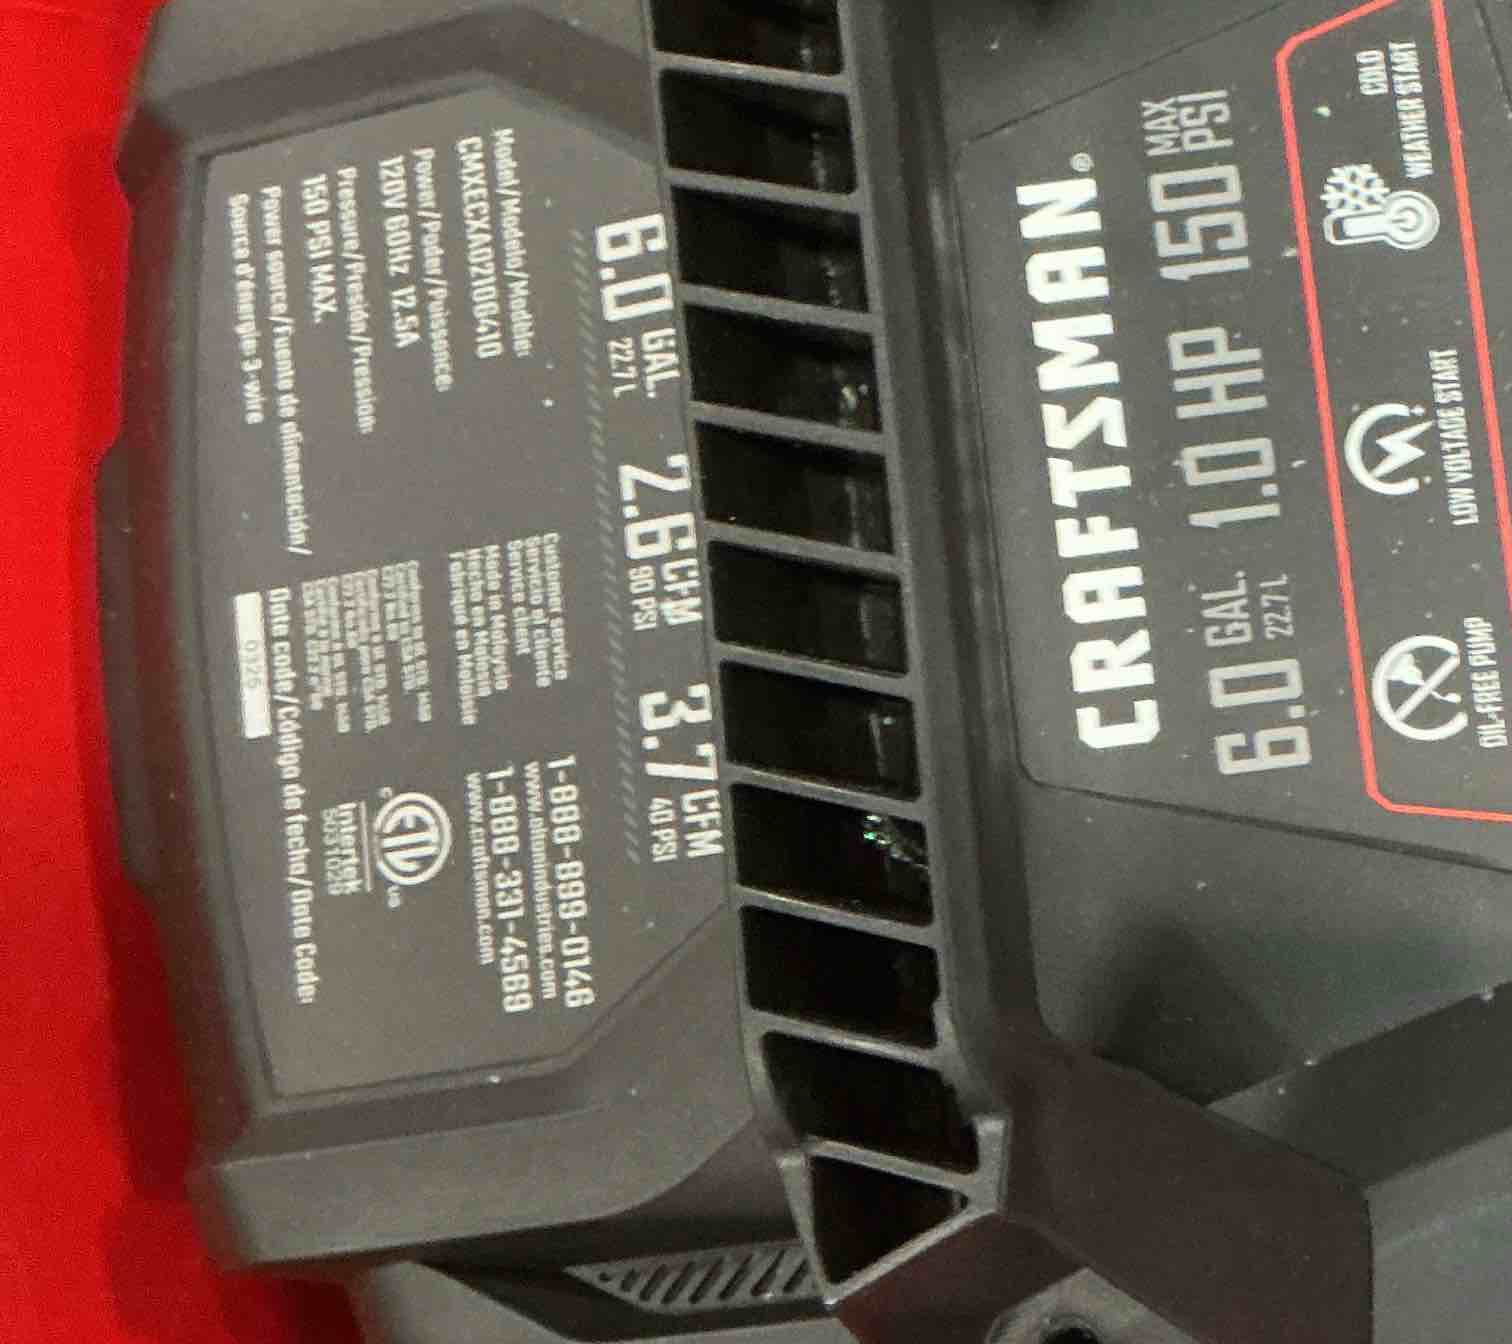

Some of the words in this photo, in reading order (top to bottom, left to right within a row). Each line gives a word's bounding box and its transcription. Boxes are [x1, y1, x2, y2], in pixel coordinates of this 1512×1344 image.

[1356, 49, 1388, 94] COLD
[1389, 40, 1423, 92] START
[1141, 95, 1180, 155] MAX
[1178, 88, 1234, 152] PSI
[1397, 97, 1434, 177] WEATHER
[300, 174, 329, 216] 150
[379, 155, 408, 208] 120V
[228, 193, 253, 261] Source
[304, 220, 332, 260] PSI
[385, 214, 414, 277] 60Hz
[1149, 163, 1251, 281] 150
[260, 186, 284, 246] Power
[279, 394, 299, 416] de
[309, 264, 338, 323] MAX.
[391, 285, 420, 348] 12.5A
[594, 214, 674, 323] 6.0
[640, 328, 680, 399] GAL.
[607, 338, 636, 377] 22.7
[1167, 326, 1268, 418] HP
[1429, 348, 1465, 403] START
[1436, 407, 1474, 483] VOLTAGE
[1181, 437, 1281, 528] 1.0
[1448, 488, 1480, 524] LOW
[485, 545, 503, 591] Made
[525, 536, 542, 605] Servicio
[618, 453, 697, 560] 2.6
[659, 558, 702, 626] CFM
[466, 548, 483, 602] Hecho
[488, 594, 504, 610] in
[507, 540, 525, 603] Service
[544, 532, 562, 614] Customer
[627, 565, 653, 595] 90
[1260, 573, 1289, 589] L
[455, 628, 469, 651] en
[472, 606, 485, 627] en
[512, 607, 531, 656] client
[631, 598, 657, 631] PSI
[1200, 570, 1252, 646] GAL.
[1262, 593, 1295, 639] 22.7
[550, 617, 570, 680] service
[1464, 616, 1499, 667] PUMP
[268, 588, 291, 636] Date
[283, 784, 304, 810] de
[1208, 657, 1312, 774] 6.0
[1470, 671, 1508, 748] OIL-FREE
[638, 683, 719, 782] 3.7
[681, 789, 723, 858] CFM
[648, 796, 674, 826] 40
[336, 802, 362, 894] Intertek
[463, 773, 497, 966] www.craftsman.com
[651, 828, 678, 863] PSI
[484, 766, 533, 1015] 1-888-331-4569
[545, 756, 595, 1010] 1-888-899-0146
